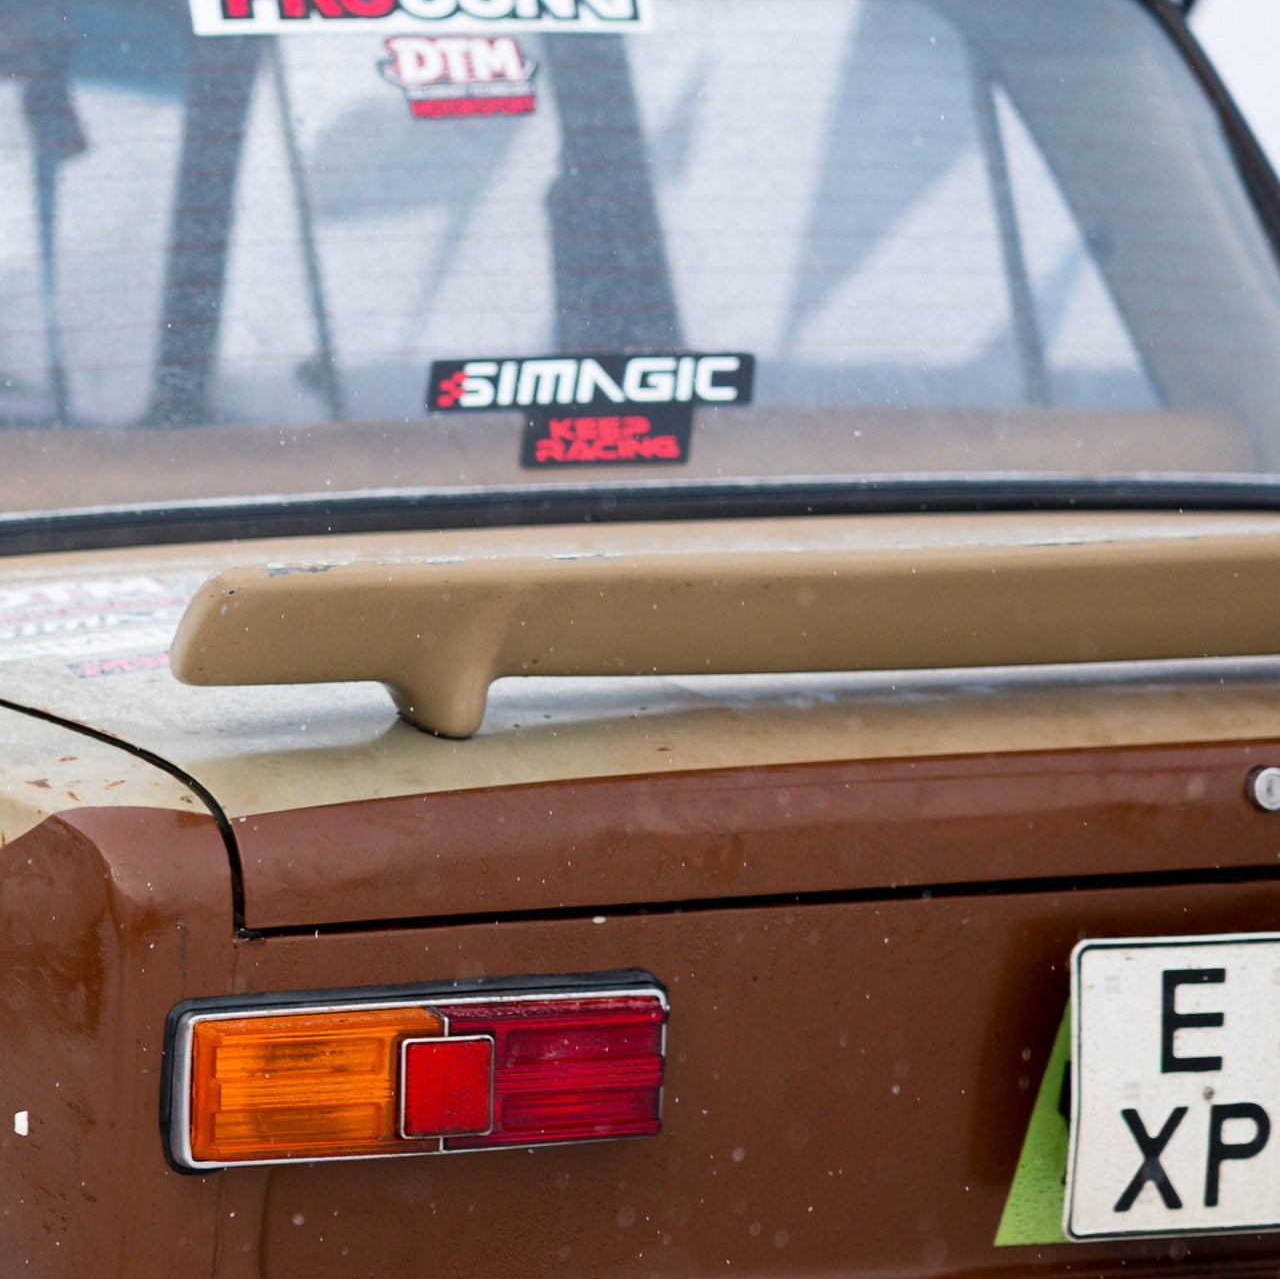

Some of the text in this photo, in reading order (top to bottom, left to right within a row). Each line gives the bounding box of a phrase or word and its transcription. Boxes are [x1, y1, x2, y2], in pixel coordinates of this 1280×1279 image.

[389, 36, 523, 85] DTM
[456, 356, 742, 408] SIMAGIC
[535, 435, 680, 462] RACING
[549, 415, 651, 441] KEEP
[1160, 968, 1226, 1073] E
[1113, 1102, 1271, 1213] XP
